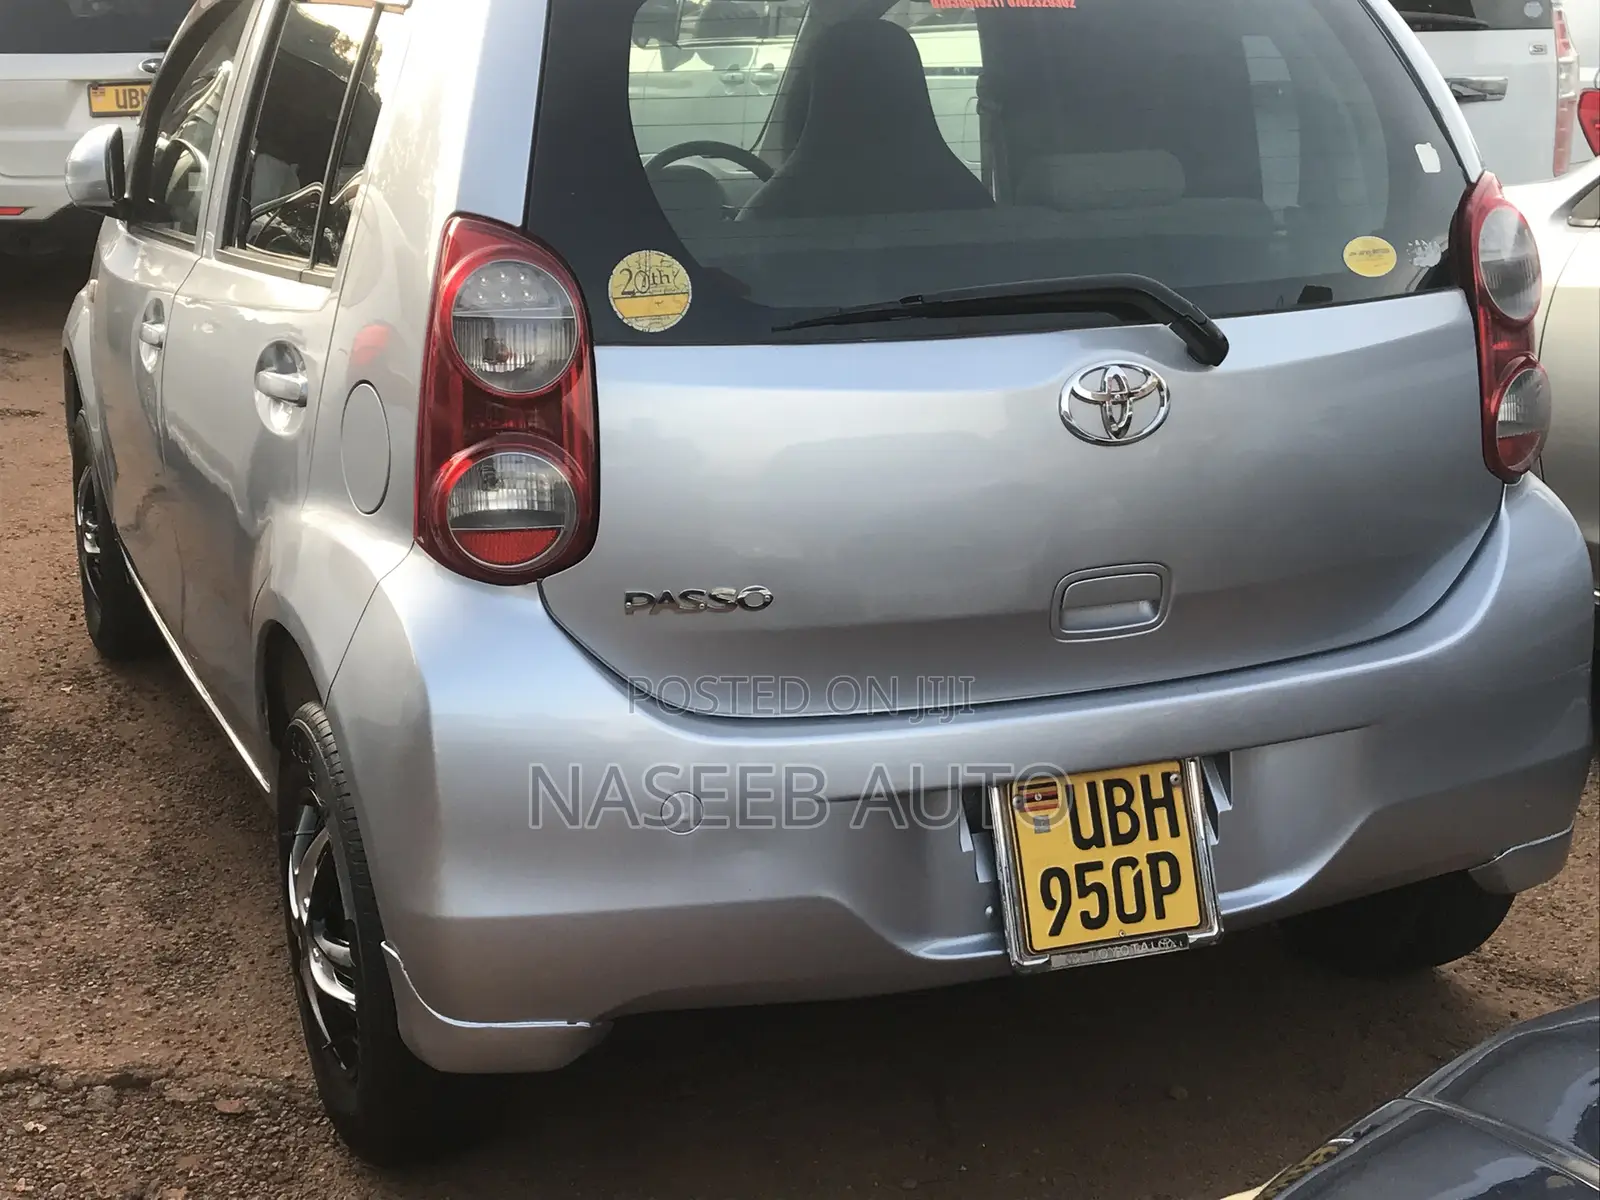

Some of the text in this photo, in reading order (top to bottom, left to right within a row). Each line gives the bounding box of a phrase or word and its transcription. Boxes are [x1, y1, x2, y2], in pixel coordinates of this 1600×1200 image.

[619, 267, 671, 295] 20th
[624, 585, 774, 615] PASSO
[1065, 771, 1181, 851] UBH
[1039, 850, 1182, 937] 950P
